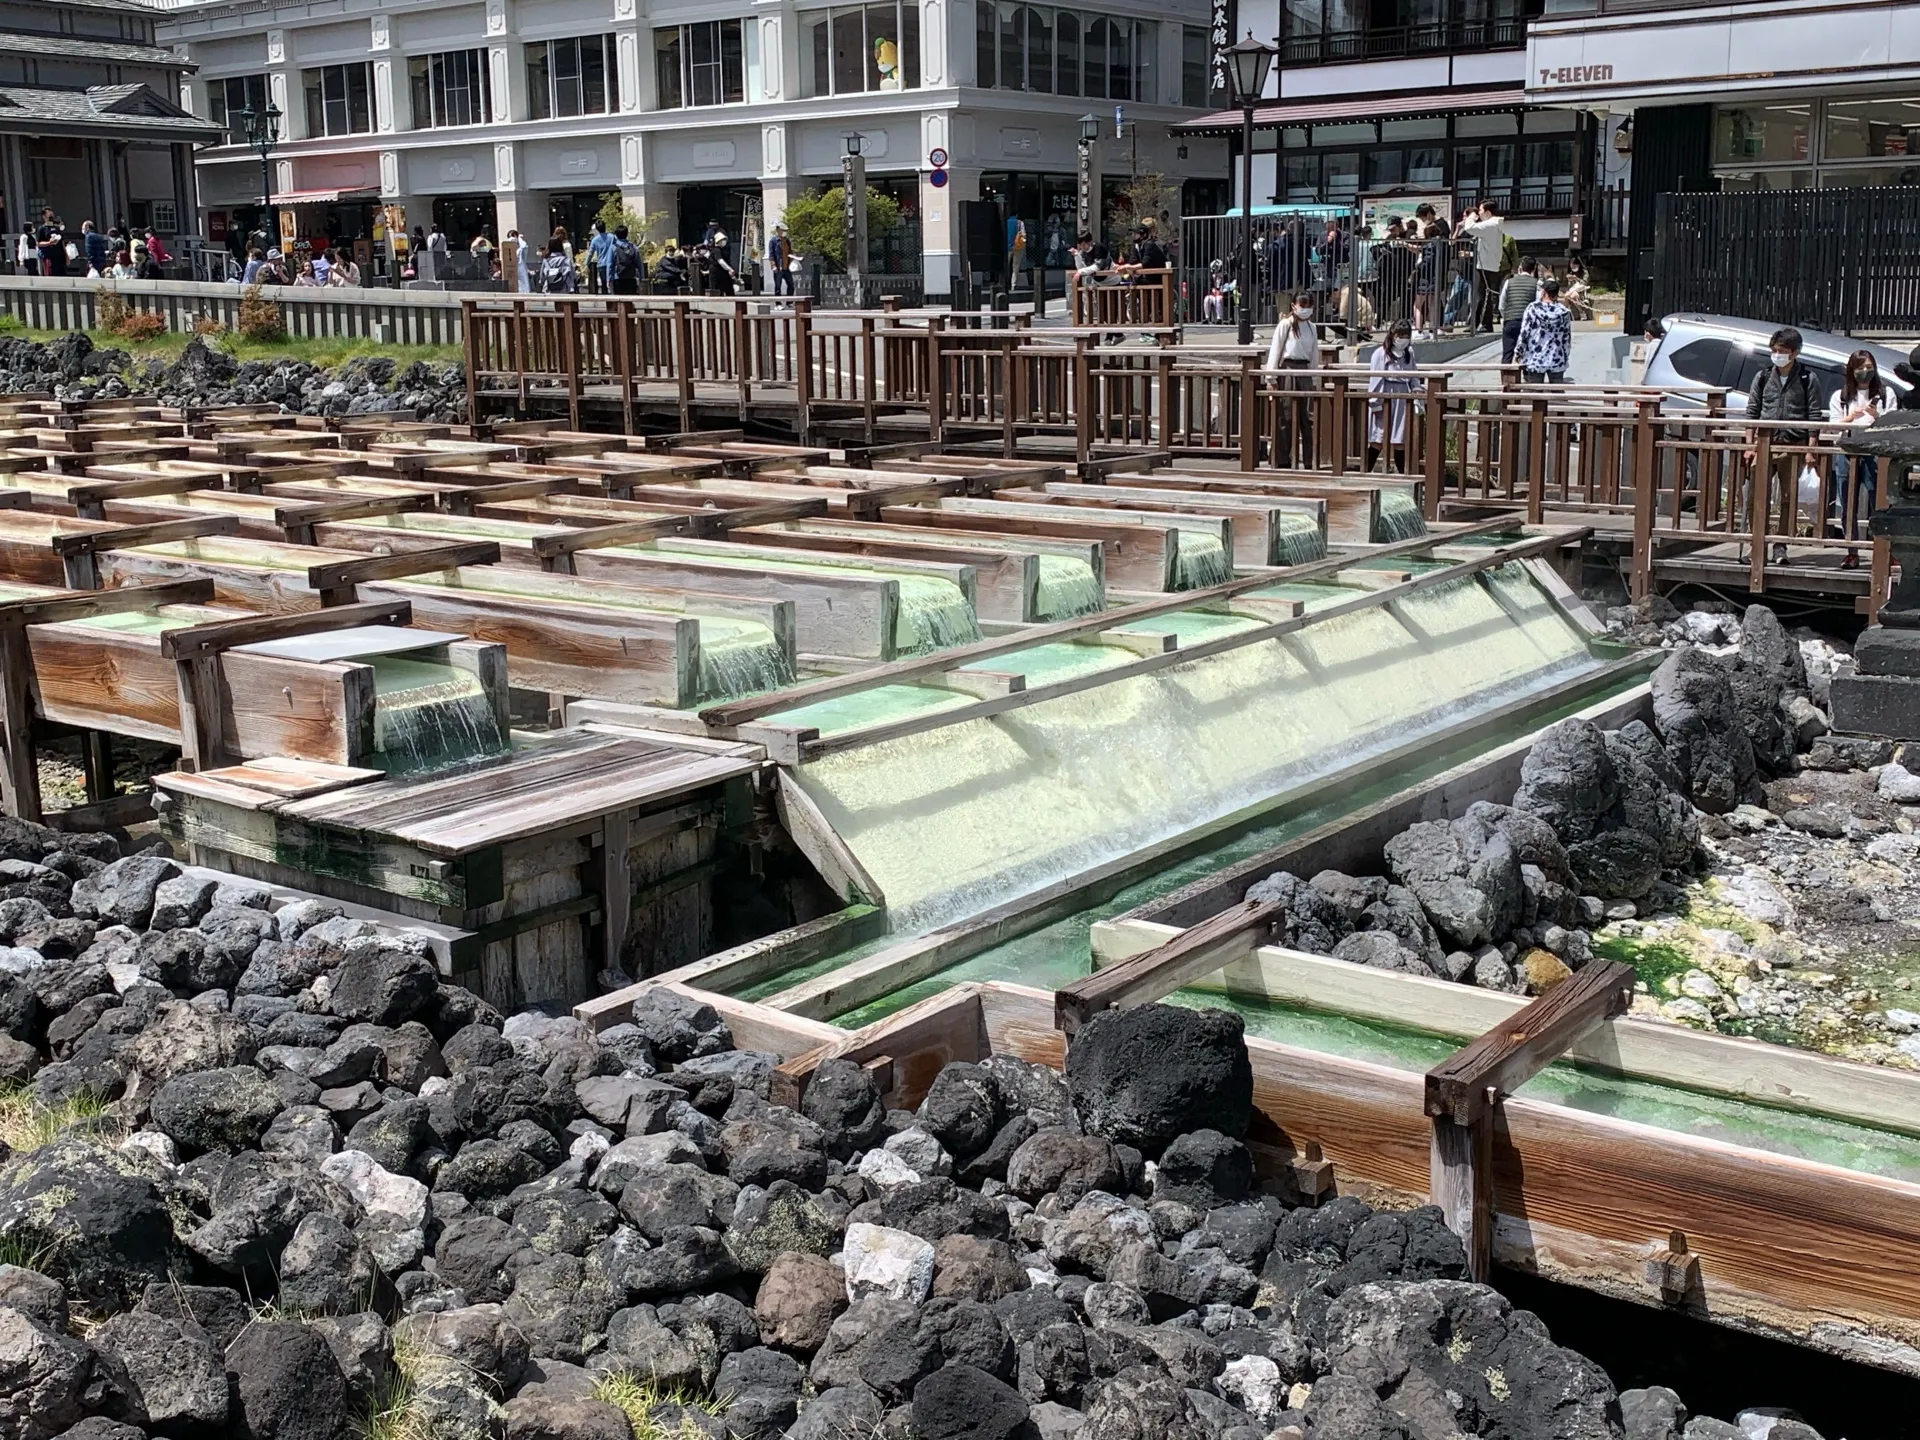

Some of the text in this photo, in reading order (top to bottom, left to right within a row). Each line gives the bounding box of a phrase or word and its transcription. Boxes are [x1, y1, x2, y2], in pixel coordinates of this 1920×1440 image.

[933, 153, 944, 163] 20
[1052, 194, 1077, 209] たばこ
